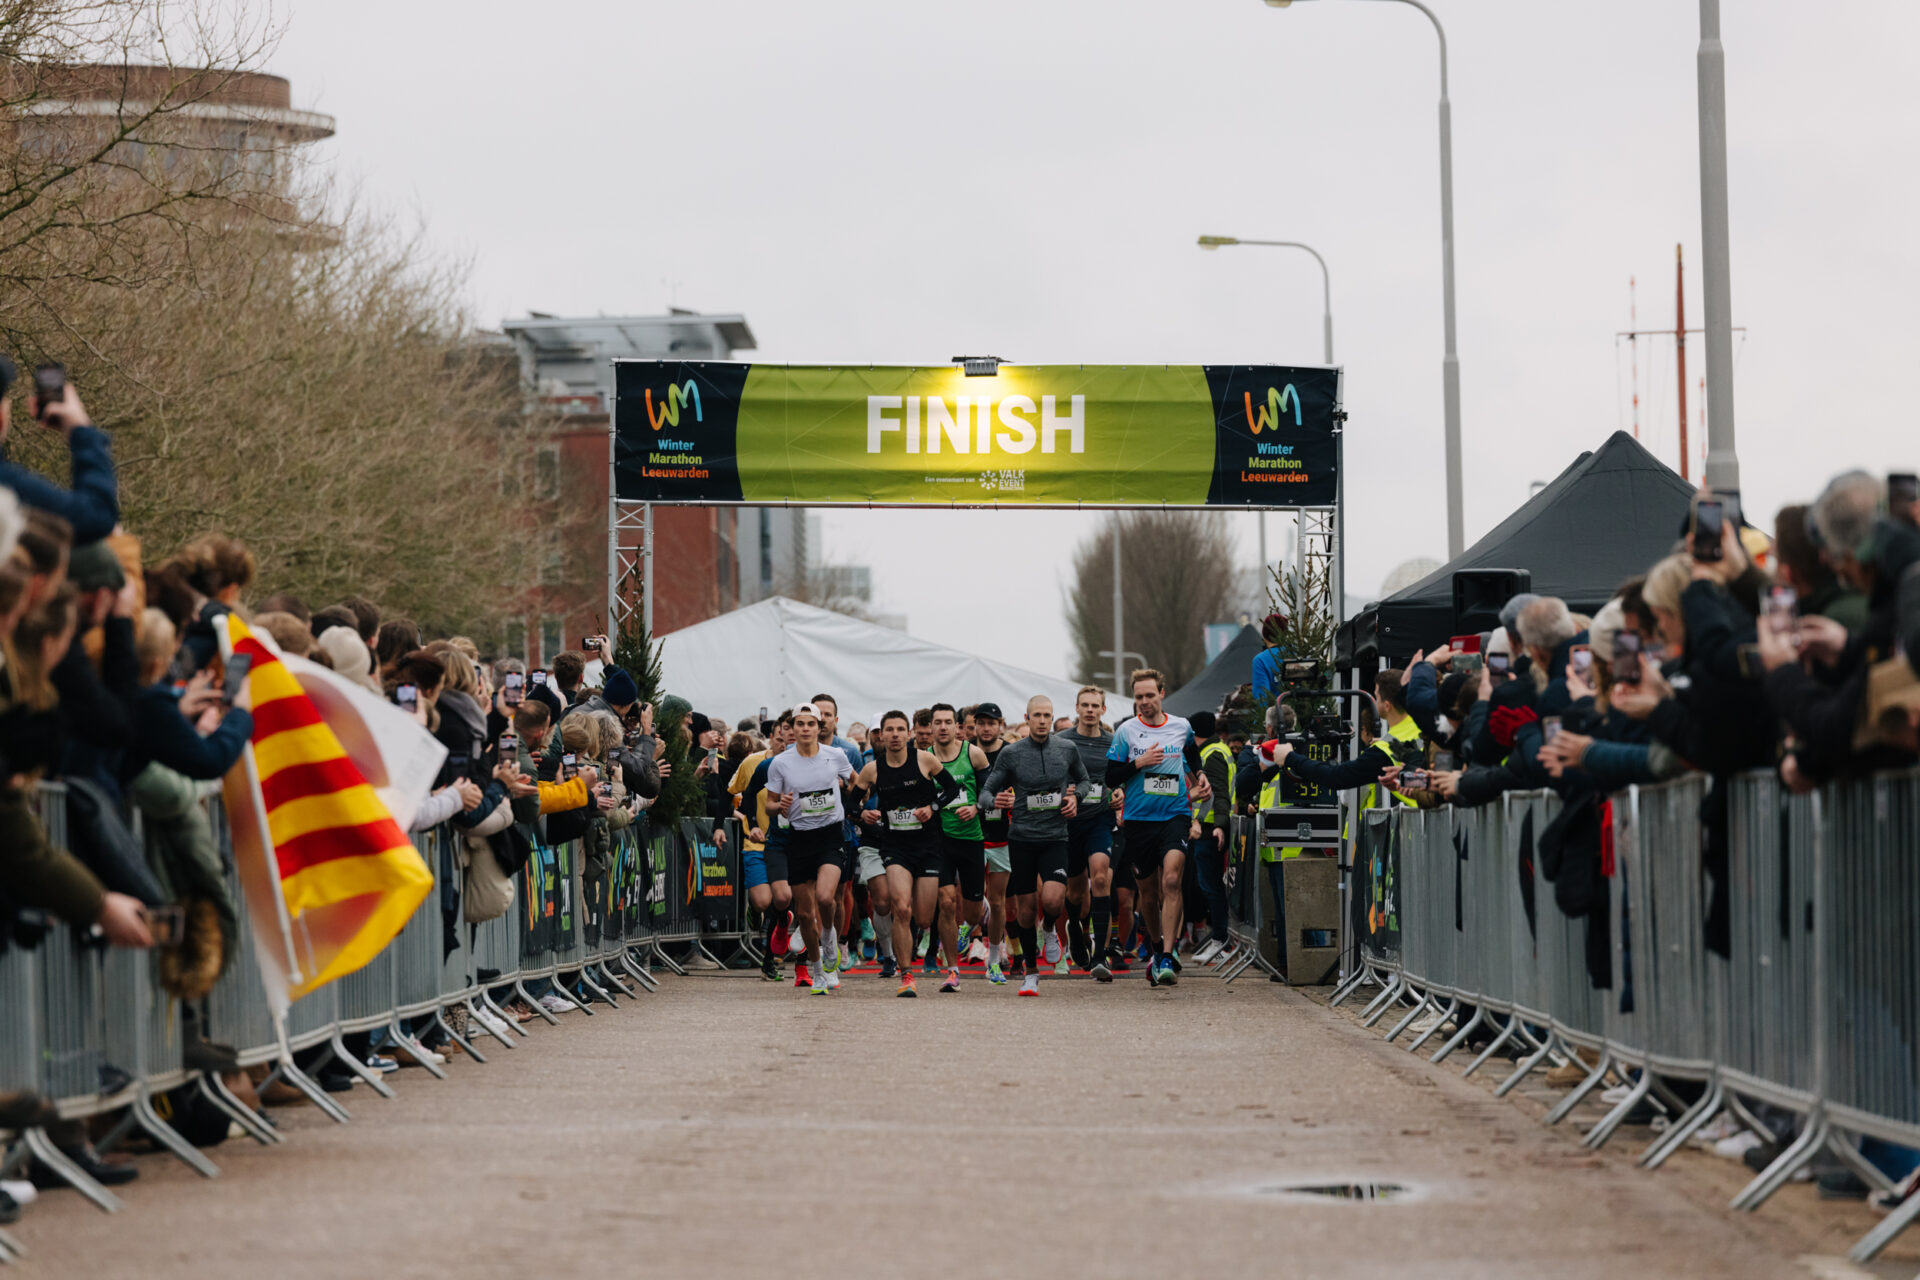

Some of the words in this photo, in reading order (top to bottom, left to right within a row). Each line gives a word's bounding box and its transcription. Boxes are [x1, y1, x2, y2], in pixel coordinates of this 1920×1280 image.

[867, 394, 1085, 454] FINISH
[658, 439, 694, 451] Winter
[1257, 443, 1294, 454] Winter
[649, 452, 702, 464] Marathon
[1249, 457, 1302, 468] Marathon
[642, 466, 709, 478] Leeuwarden
[999, 469, 1025, 479] VALK
[1241, 471, 1308, 482] Leeuwarden
[999, 479, 1025, 488] EVENT
[1153, 780, 1171, 789] 2011
[809, 796, 827, 807] 1551
[1036, 795, 1054, 805] 1163
[894, 811, 912, 820] 1817
